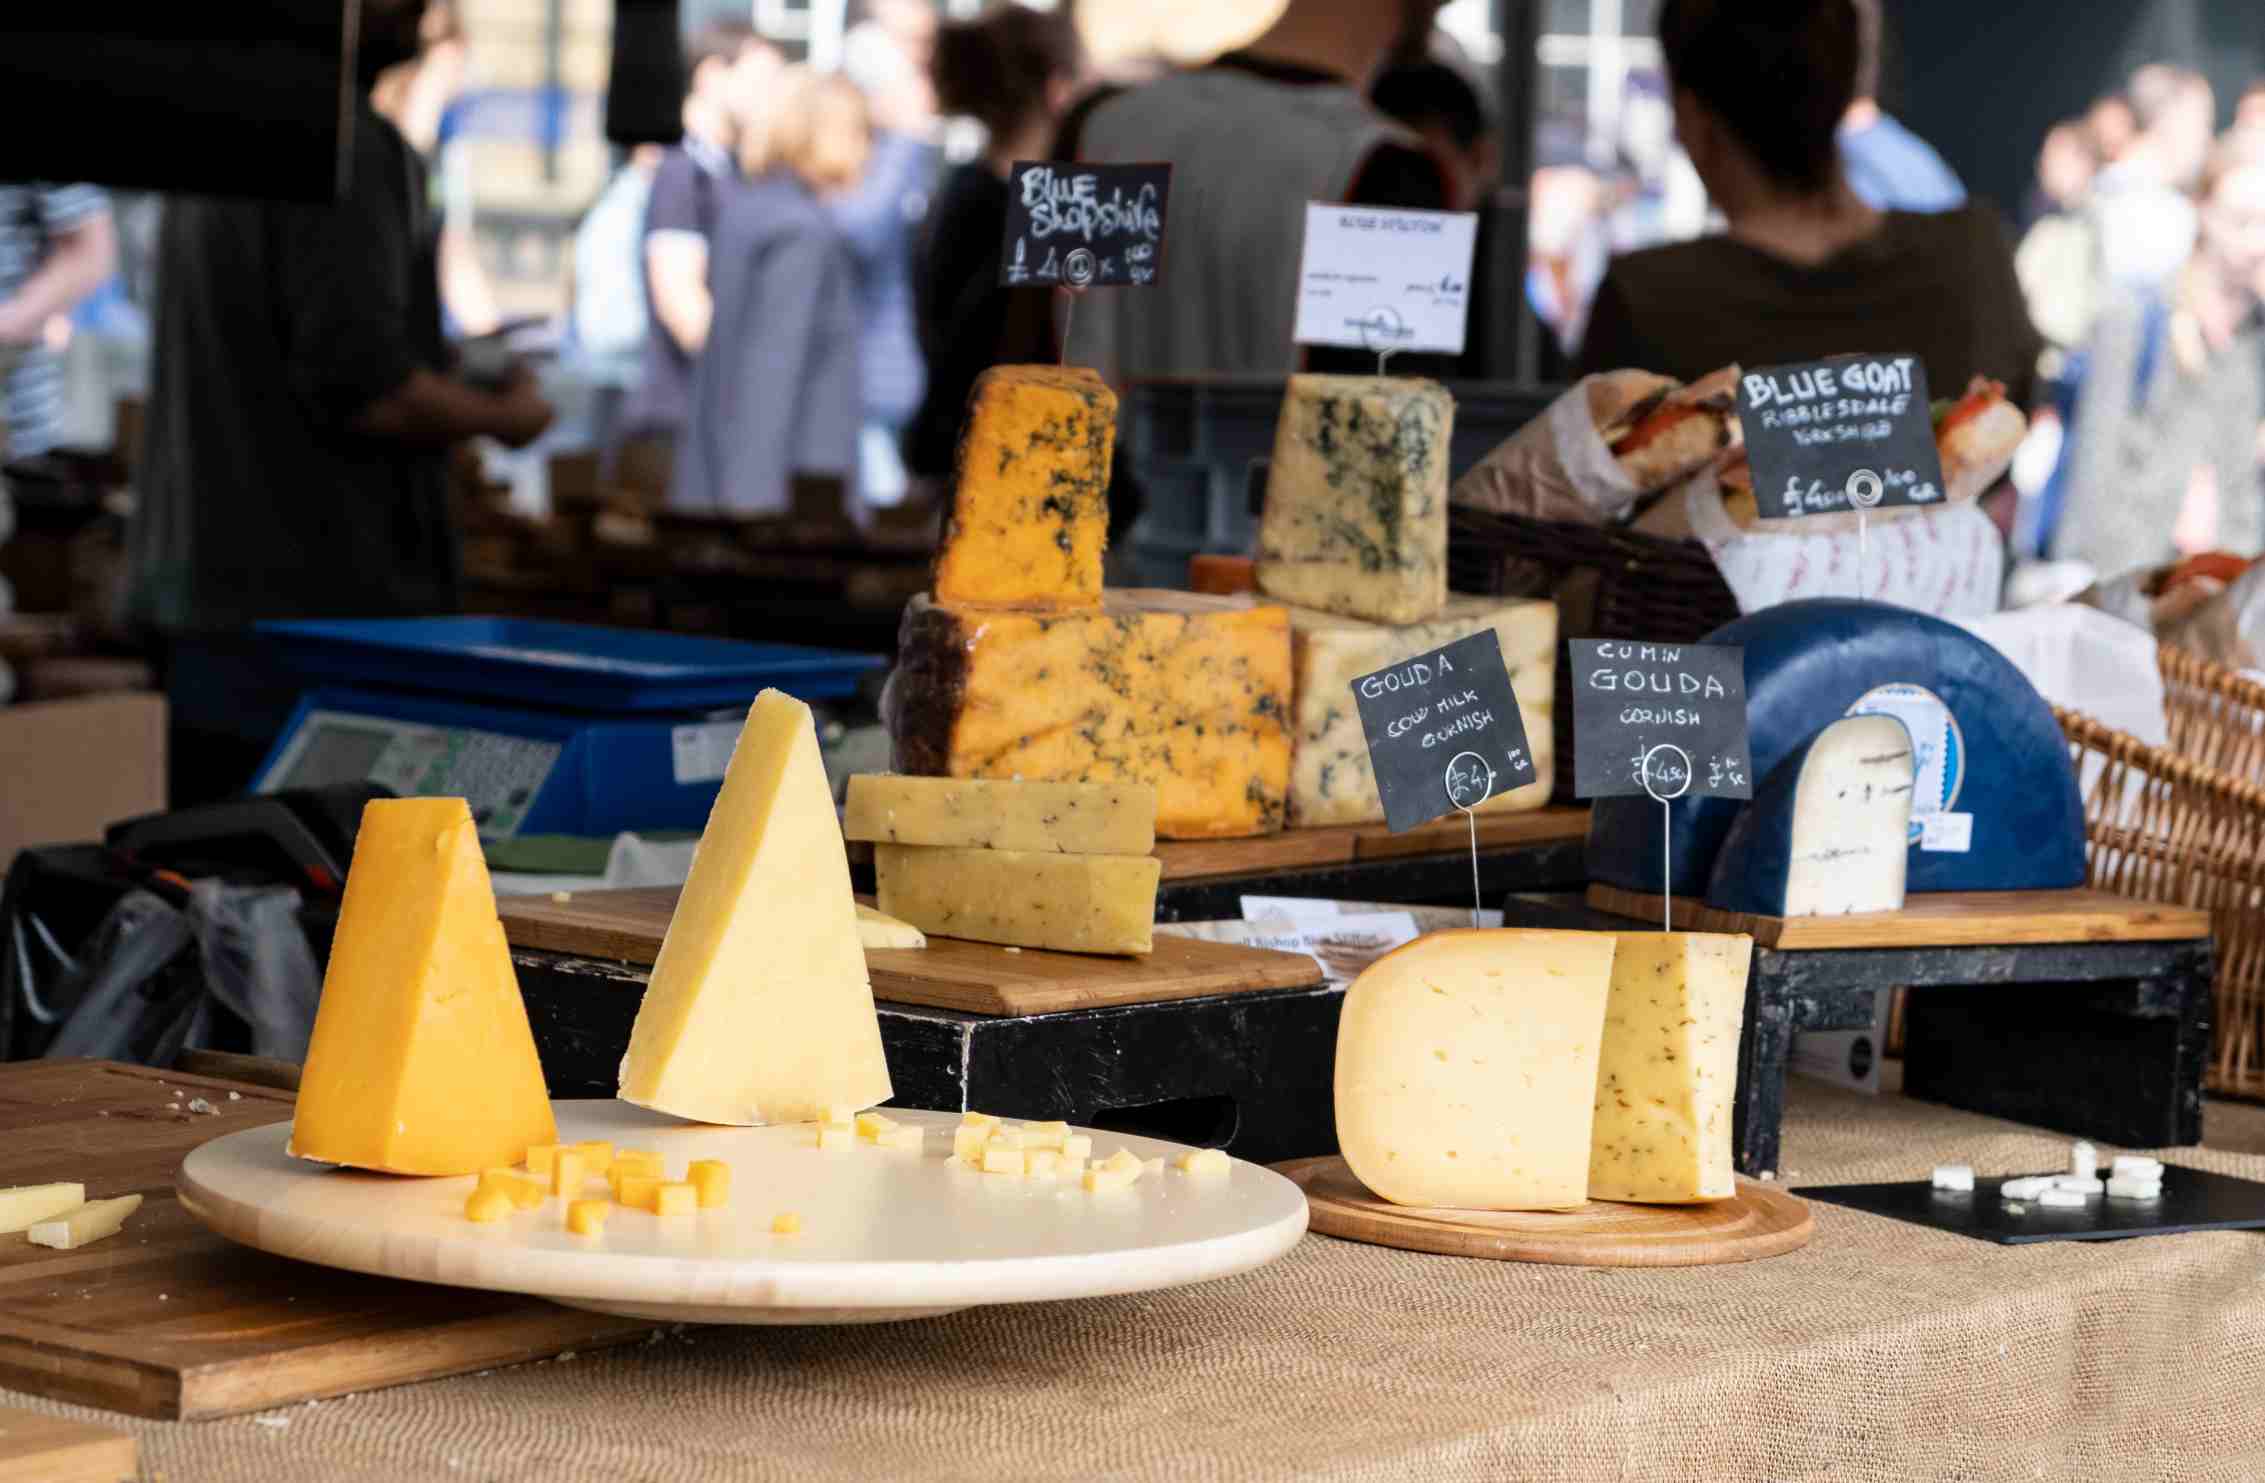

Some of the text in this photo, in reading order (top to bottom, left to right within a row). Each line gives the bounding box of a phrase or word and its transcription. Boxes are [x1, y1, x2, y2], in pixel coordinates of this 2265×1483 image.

[1743, 358, 1913, 409] BLUE GOAT
[1760, 393, 1911, 429] RIBBLESDALE
[1597, 643, 1681, 663] CUMIN
[1360, 653, 1454, 699] GOUDA
[1589, 668, 1725, 699] GOUDA
[1387, 688, 1480, 738] COW MILK
[1620, 706, 1701, 725] CORNISH
